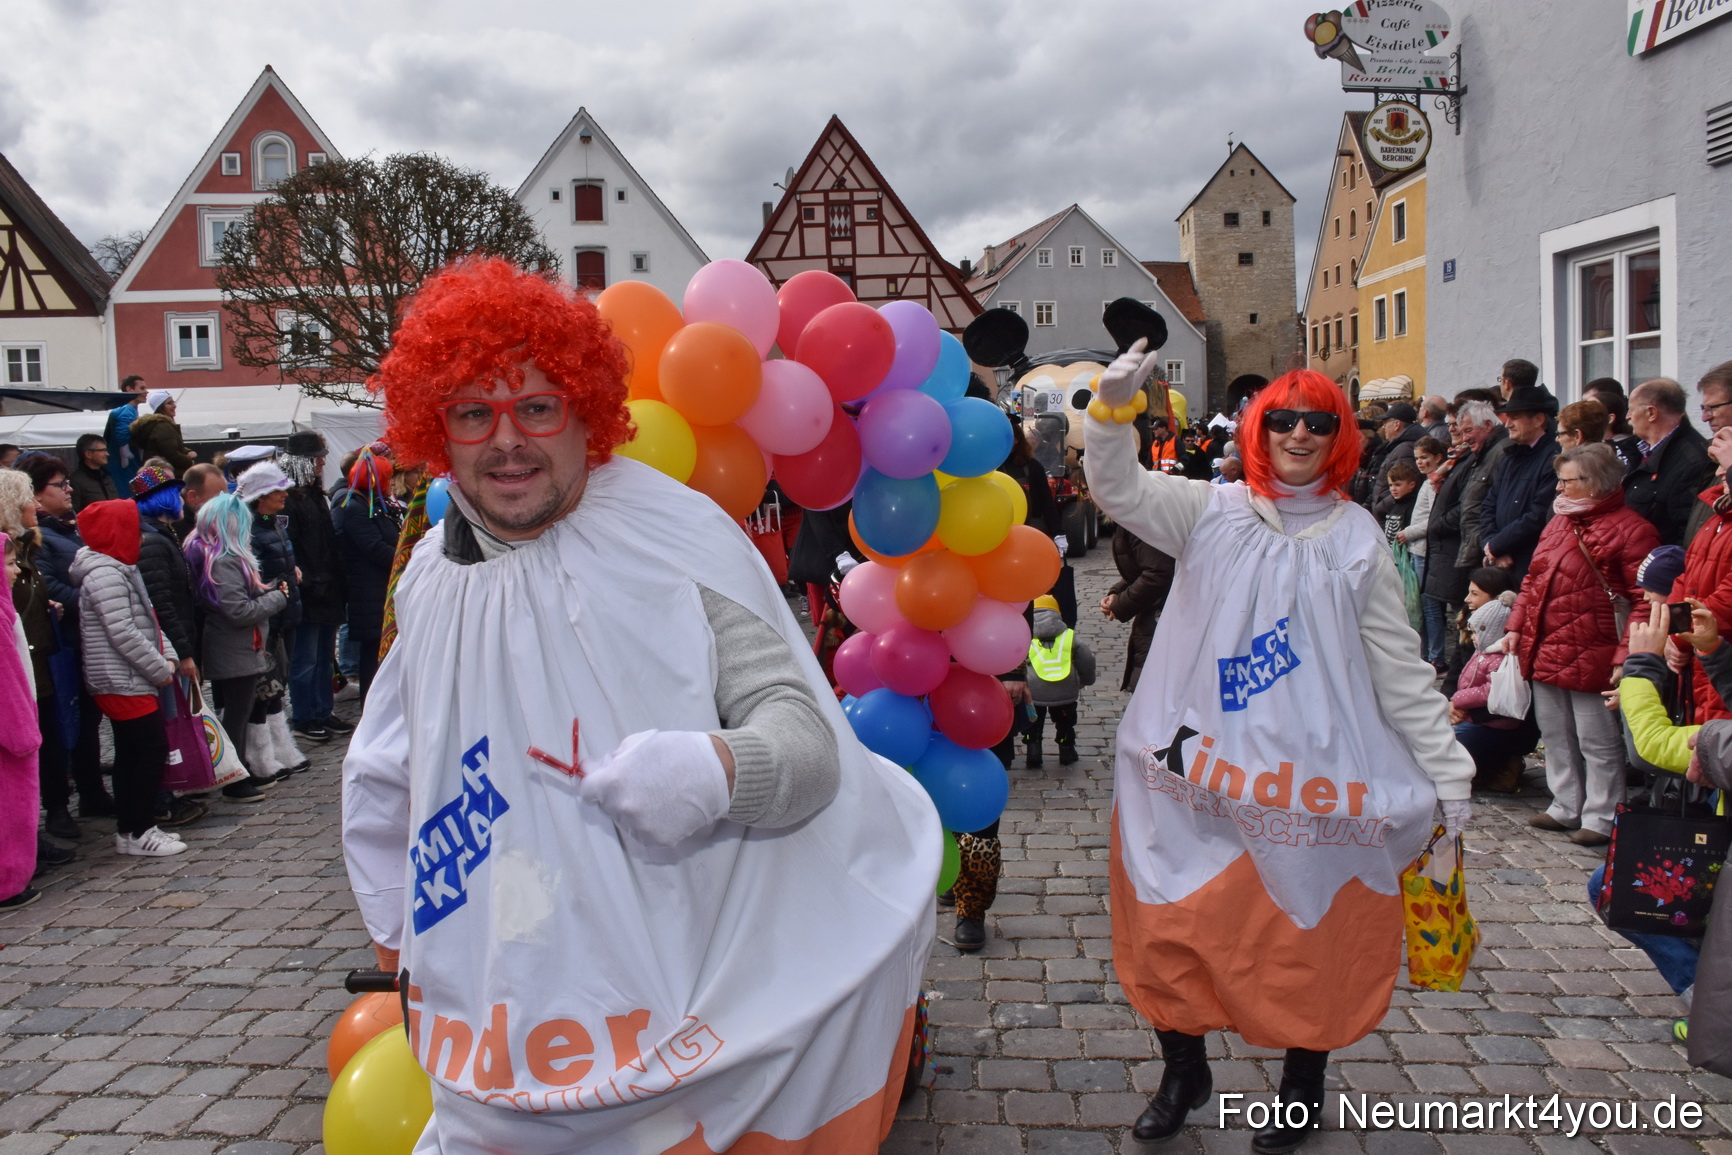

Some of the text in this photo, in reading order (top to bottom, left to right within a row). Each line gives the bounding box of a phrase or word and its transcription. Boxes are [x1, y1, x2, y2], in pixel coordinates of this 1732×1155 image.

[1366, 0, 1423, 12] Pizzeria
[1380, 18, 1411, 31] Café
[1365, 34, 1425, 51] Eisdiele
[1376, 65, 1417, 75] Bella
[1348, 74, 1392, 83] Roma
[1382, 154, 1414, 162] BERCHING
[1050, 393, 1063, 404] 30
[1653, 845, 1696, 854] LIMITED
